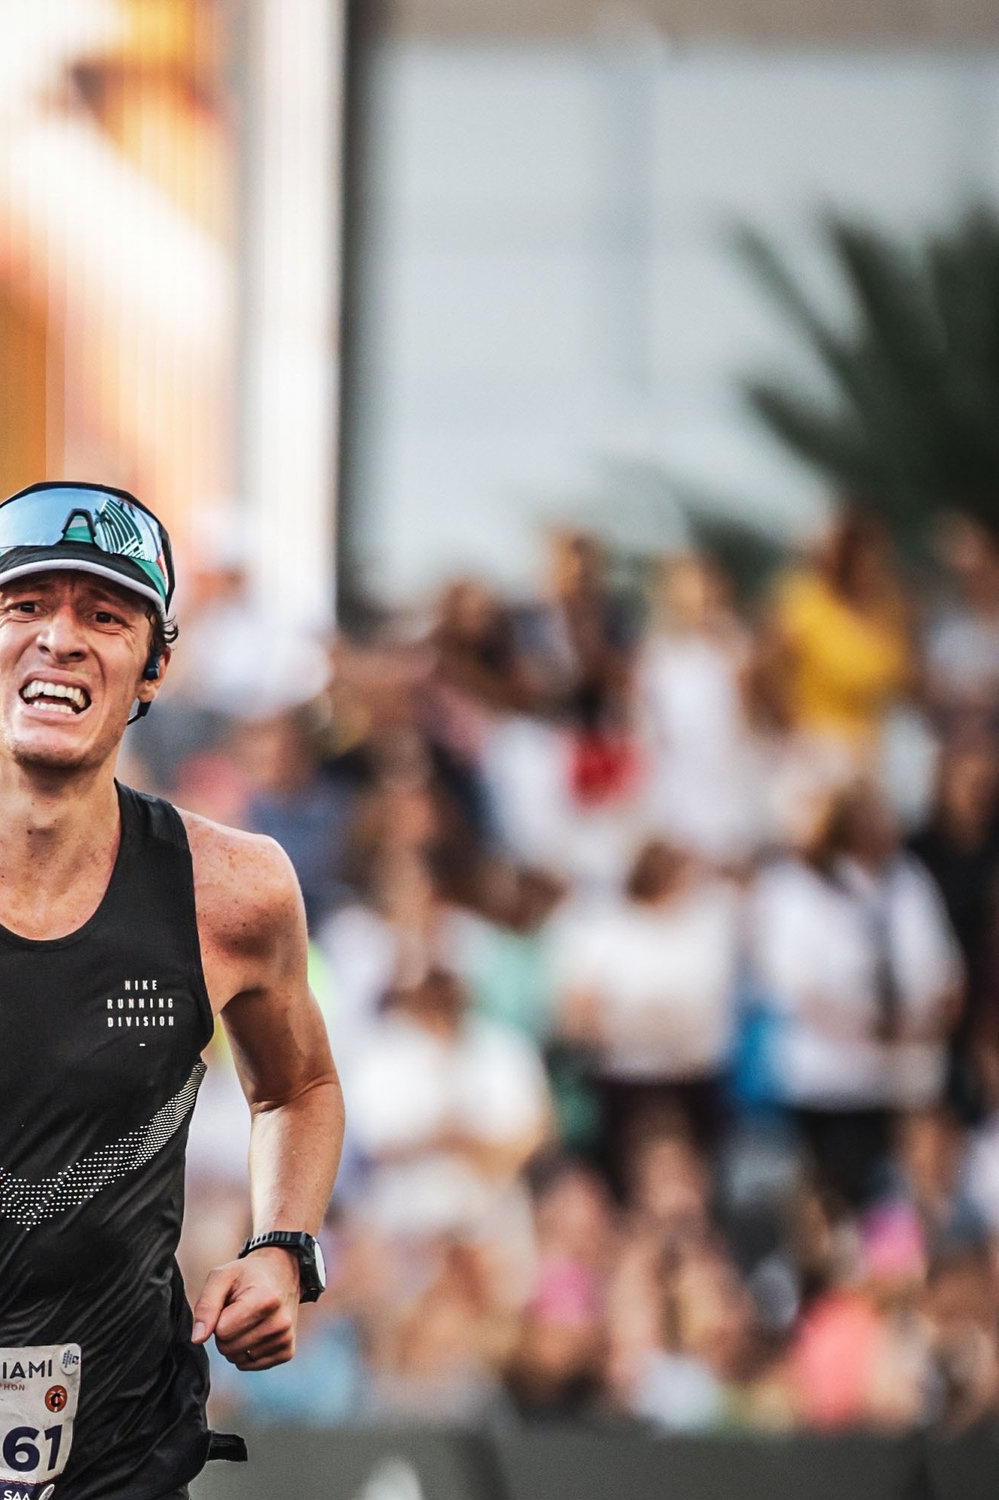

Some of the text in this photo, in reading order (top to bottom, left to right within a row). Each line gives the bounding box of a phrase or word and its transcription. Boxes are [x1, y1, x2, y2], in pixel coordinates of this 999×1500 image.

[124, 979, 158, 991] NIKE
[106, 998, 174, 1009] RUNNING
[107, 1016, 174, 1028] DIVISION
